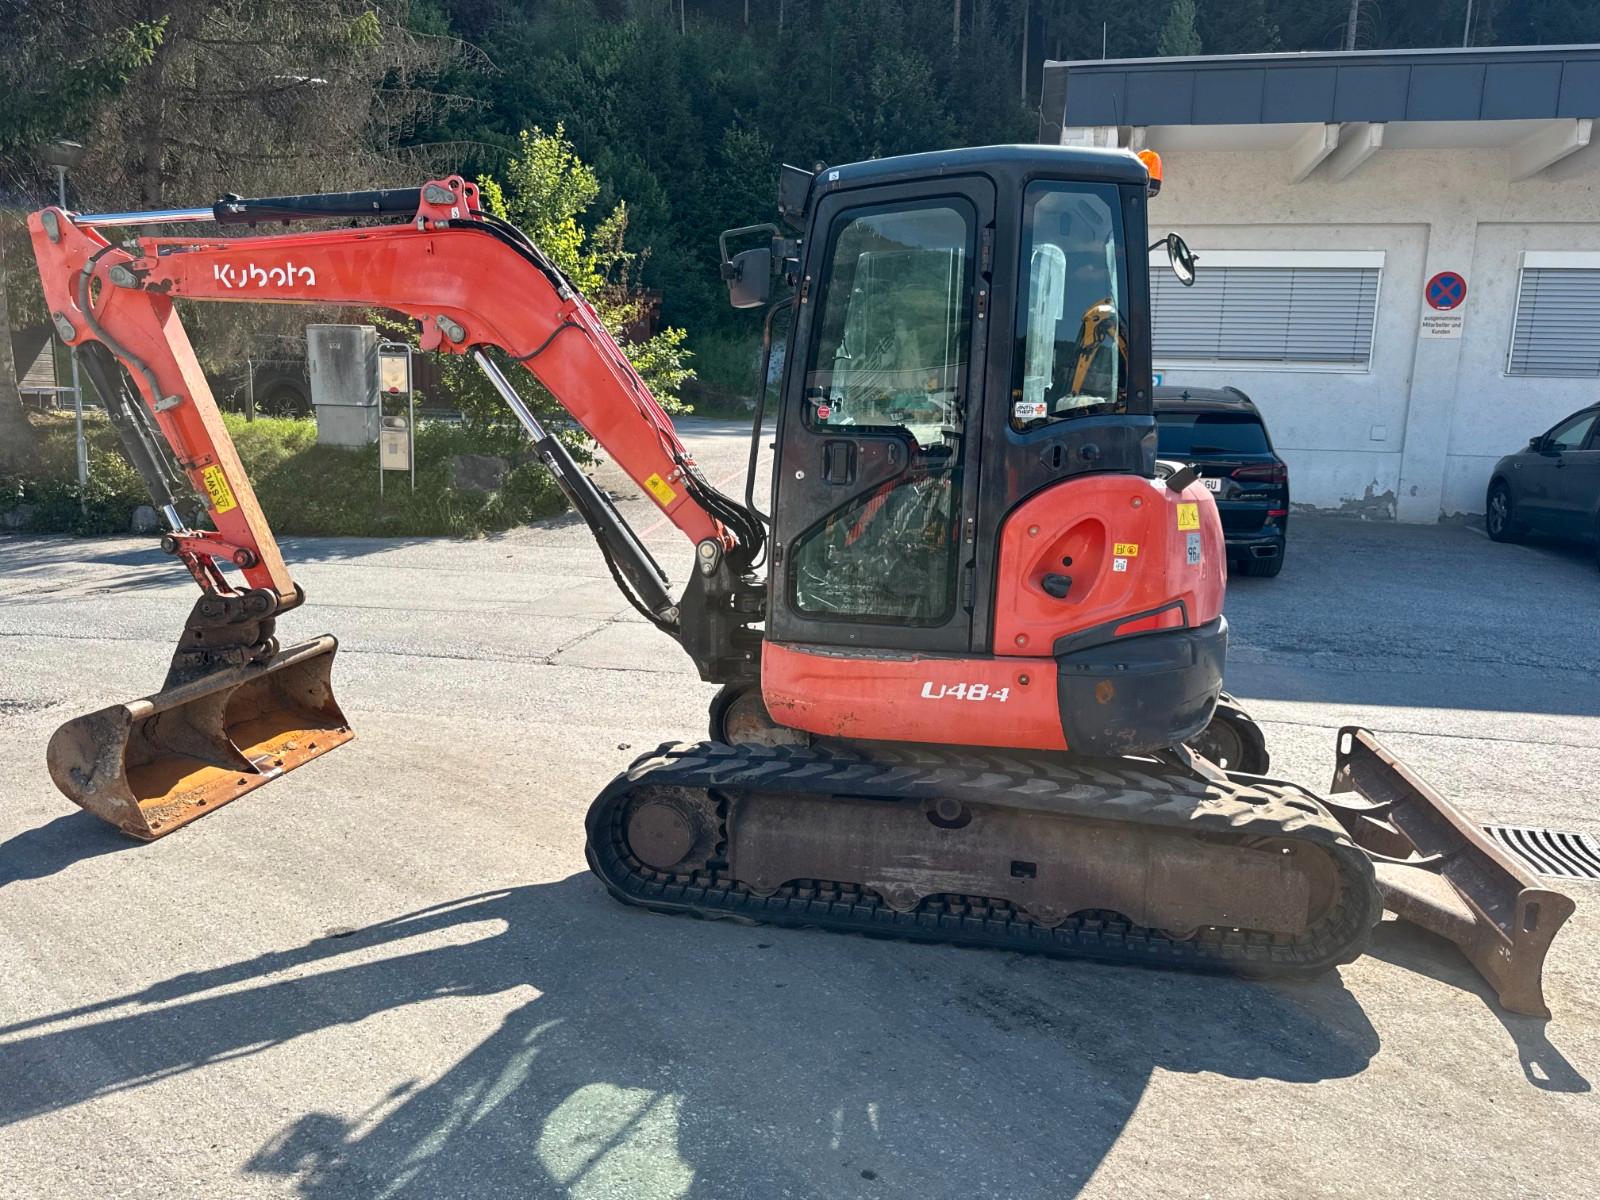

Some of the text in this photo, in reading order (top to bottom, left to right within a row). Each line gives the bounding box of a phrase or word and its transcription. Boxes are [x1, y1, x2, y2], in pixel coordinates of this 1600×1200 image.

[213, 262, 316, 288] Kubota
[1188, 546, 1197, 562] 96
[920, 681, 1010, 702] U48-4
